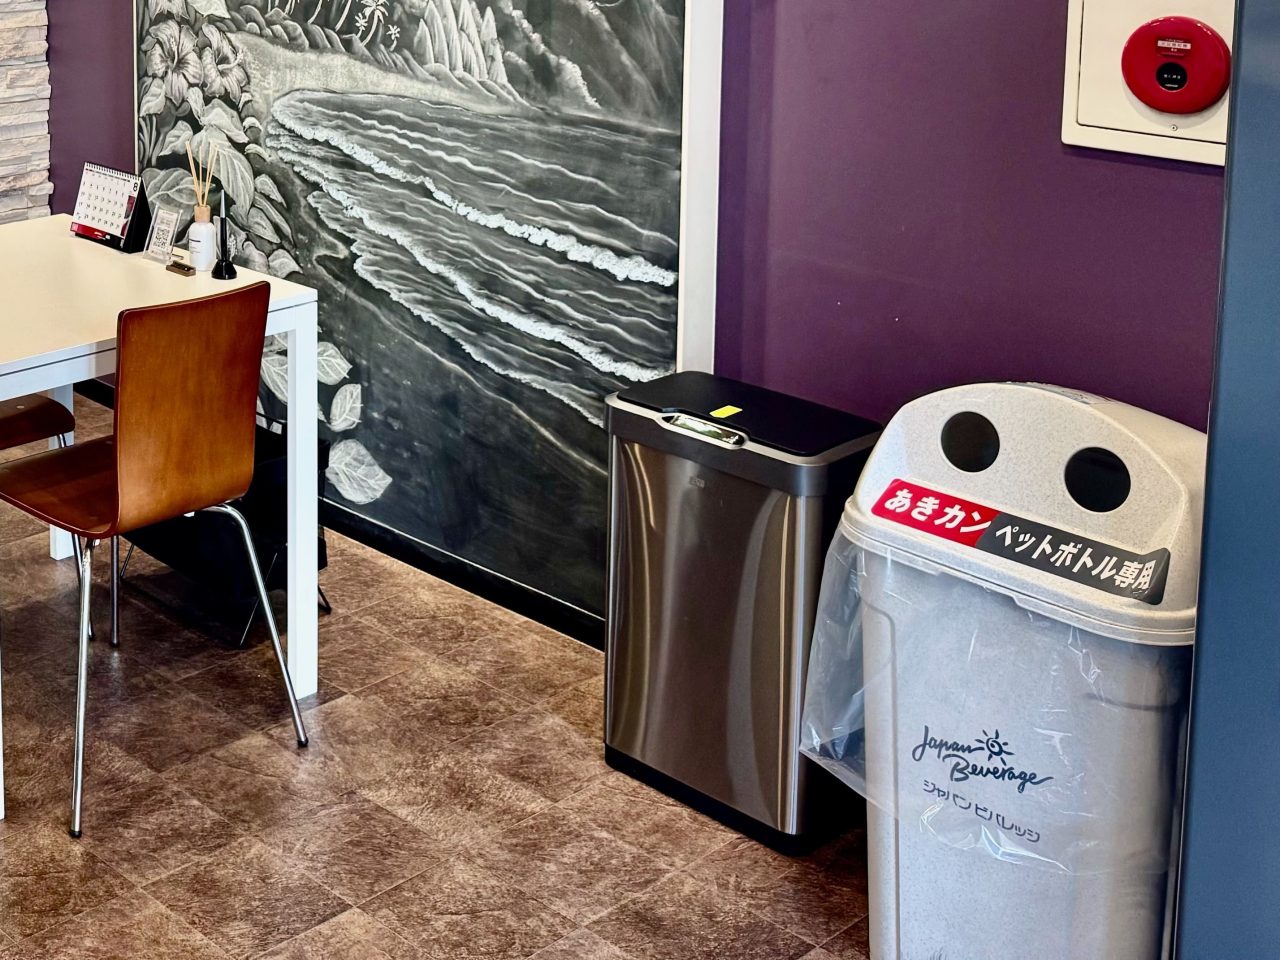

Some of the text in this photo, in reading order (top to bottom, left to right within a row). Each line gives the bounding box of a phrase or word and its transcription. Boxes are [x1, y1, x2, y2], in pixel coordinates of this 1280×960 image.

[885, 488, 1157, 589] あきカン ペットボトル専用
[912, 725, 985, 761] Japan
[943, 753, 1054, 793] Beverage
